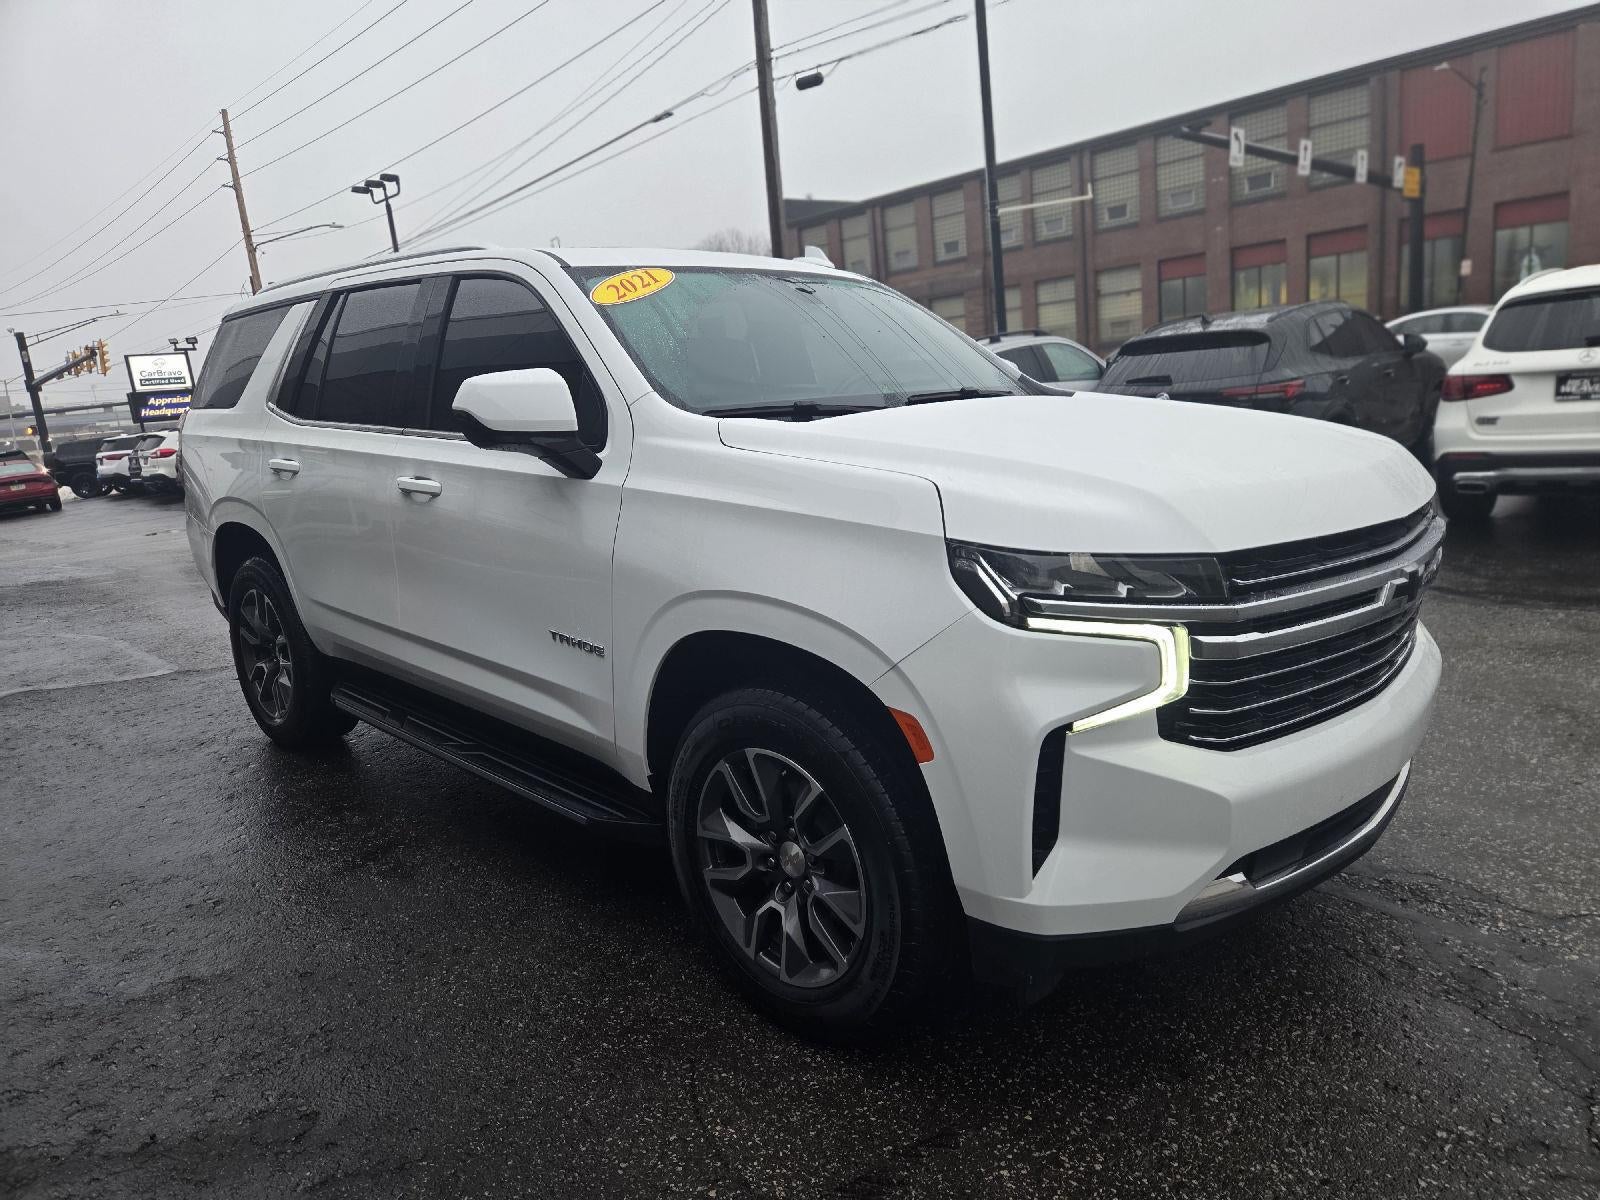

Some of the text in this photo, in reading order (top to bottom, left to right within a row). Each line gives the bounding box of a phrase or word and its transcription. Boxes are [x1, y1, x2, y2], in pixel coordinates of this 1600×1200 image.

[606, 270, 661, 300] 2021
[148, 395, 191, 406] Appraisal
[548, 629, 605, 657] TAHOE
